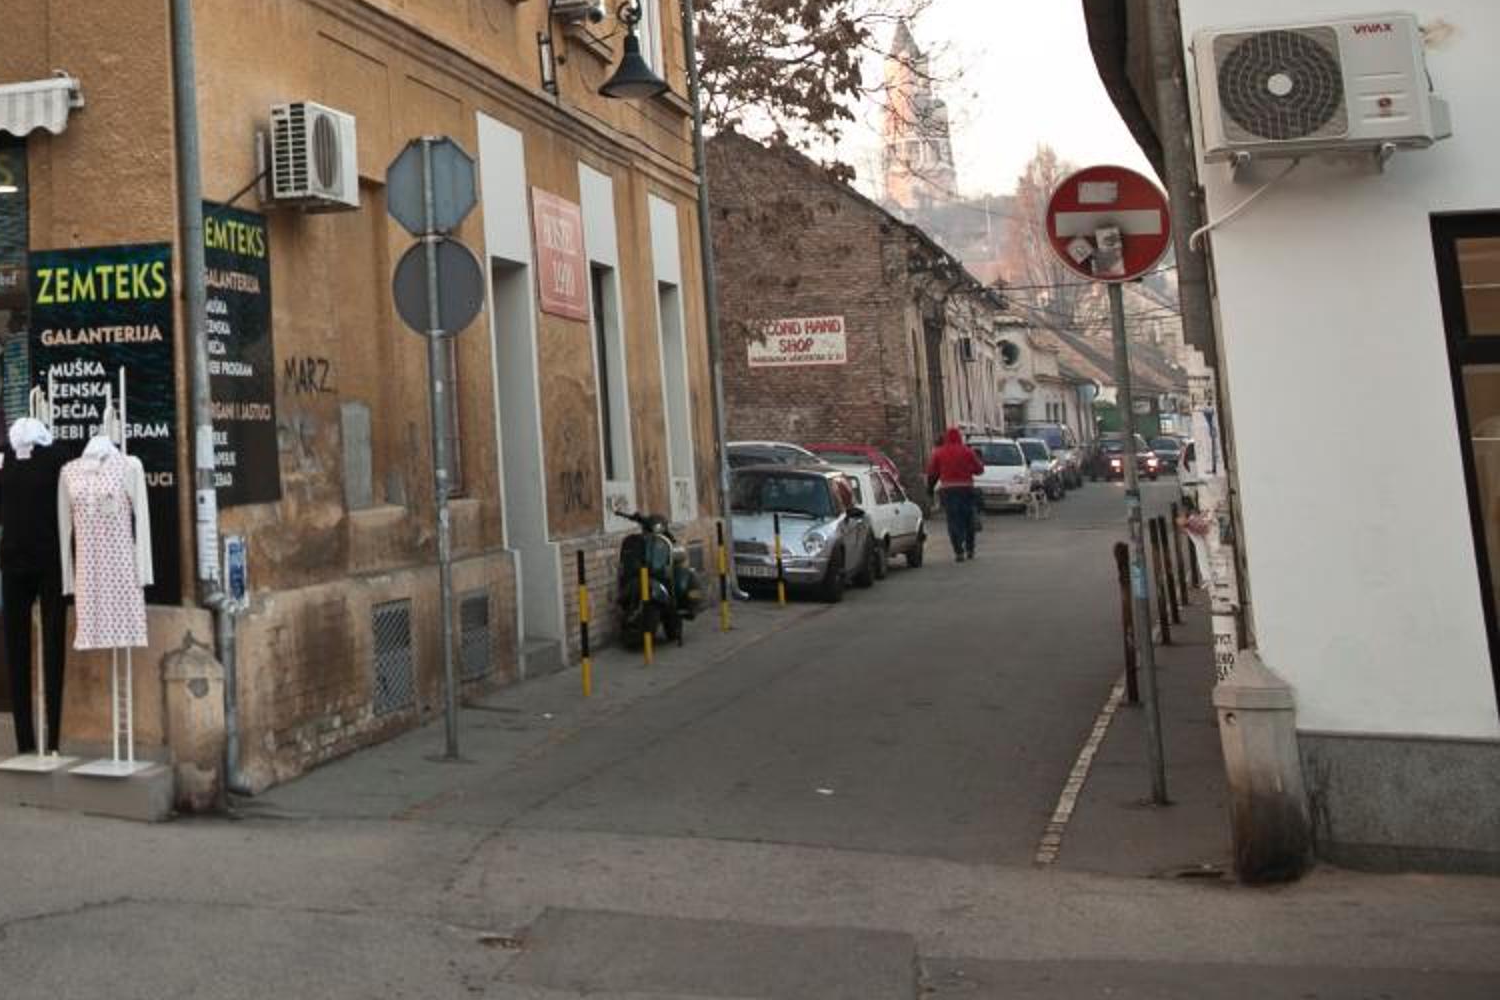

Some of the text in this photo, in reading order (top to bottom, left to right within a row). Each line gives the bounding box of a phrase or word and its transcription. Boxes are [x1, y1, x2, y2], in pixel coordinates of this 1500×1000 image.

[204, 216, 265, 258] EMTEKS
[35, 260, 167, 304] ZEMTEKS
[41, 323, 163, 347] GALANTERIJA
[780, 338, 814, 353] SHOP
[50, 358, 106, 377] MUŠKA
[52, 400, 99, 418] DEČJA
[52, 423, 169, 439] BEBI PGRAM
